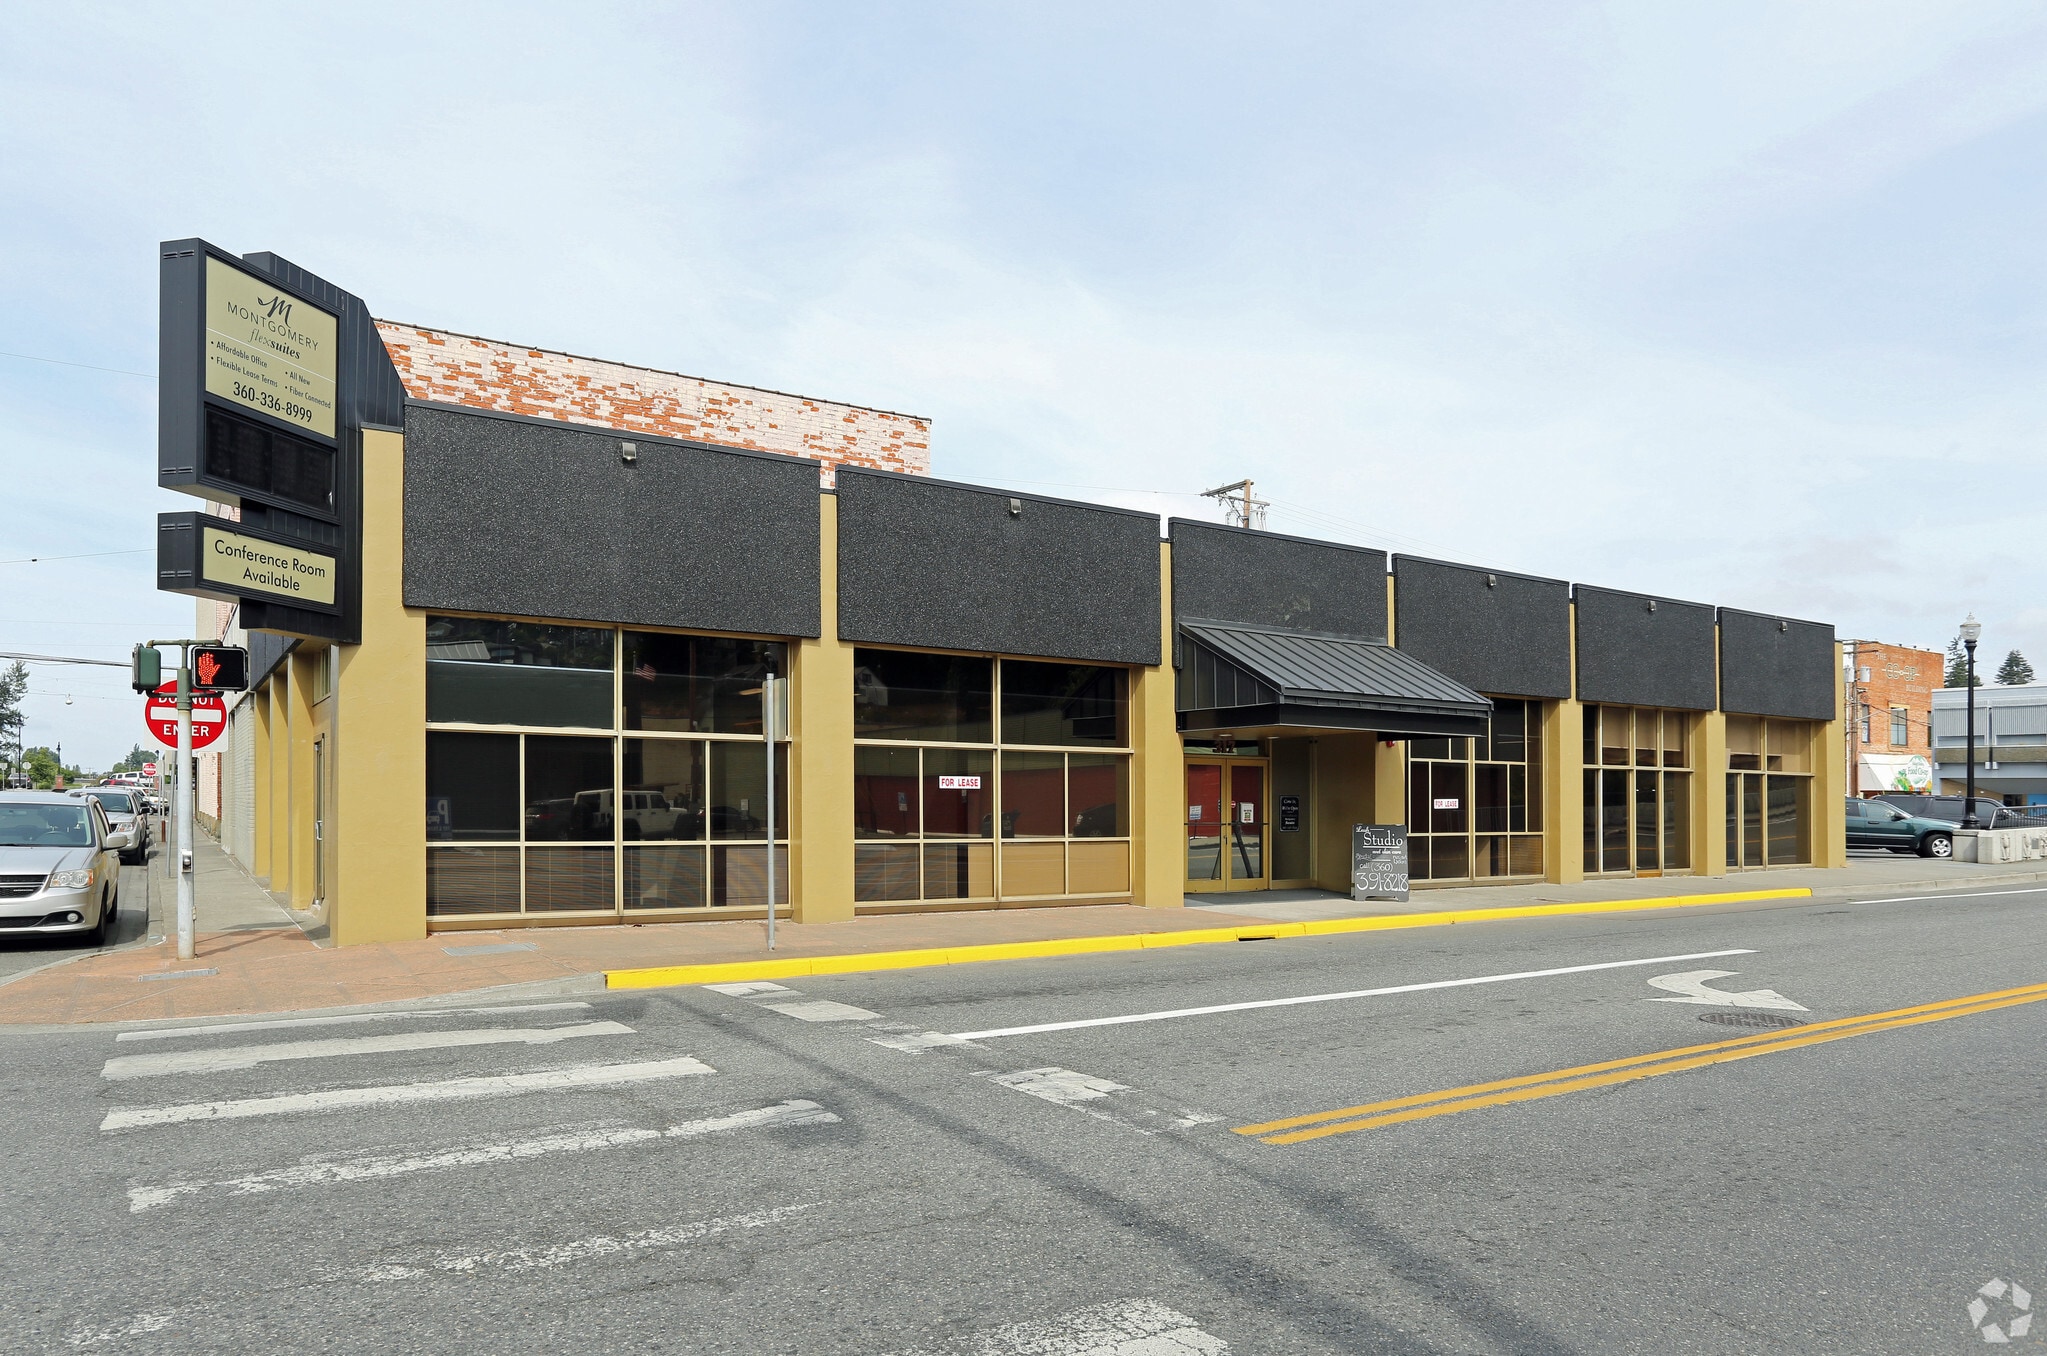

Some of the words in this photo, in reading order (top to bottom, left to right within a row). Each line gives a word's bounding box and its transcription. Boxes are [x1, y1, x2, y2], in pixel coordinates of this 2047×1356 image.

[227, 301, 319, 352] MONTGOMERY
[216, 341, 250, 361] Affordable
[250, 354, 268, 368] Office
[216, 356, 241, 373] Flexible
[242, 367, 260, 381] Lease
[261, 374, 278, 388] Terms
[289, 371, 298, 380] All
[298, 374, 311, 386] New
[233, 381, 313, 423] 360-336-8999
[289, 385, 304, 397] Fiber
[304, 392, 332, 409] Connected
[214, 539, 289, 569] Conference
[292, 557, 326, 578] Room
[242, 567, 301, 591] Available
[163, 723, 210, 737] ENER
[941, 778, 955, 787] FOR
[957, 778, 979, 787] LEASE
[1364, 830, 1403, 846] Studio
[1371, 863, 1393, 872] (360)
